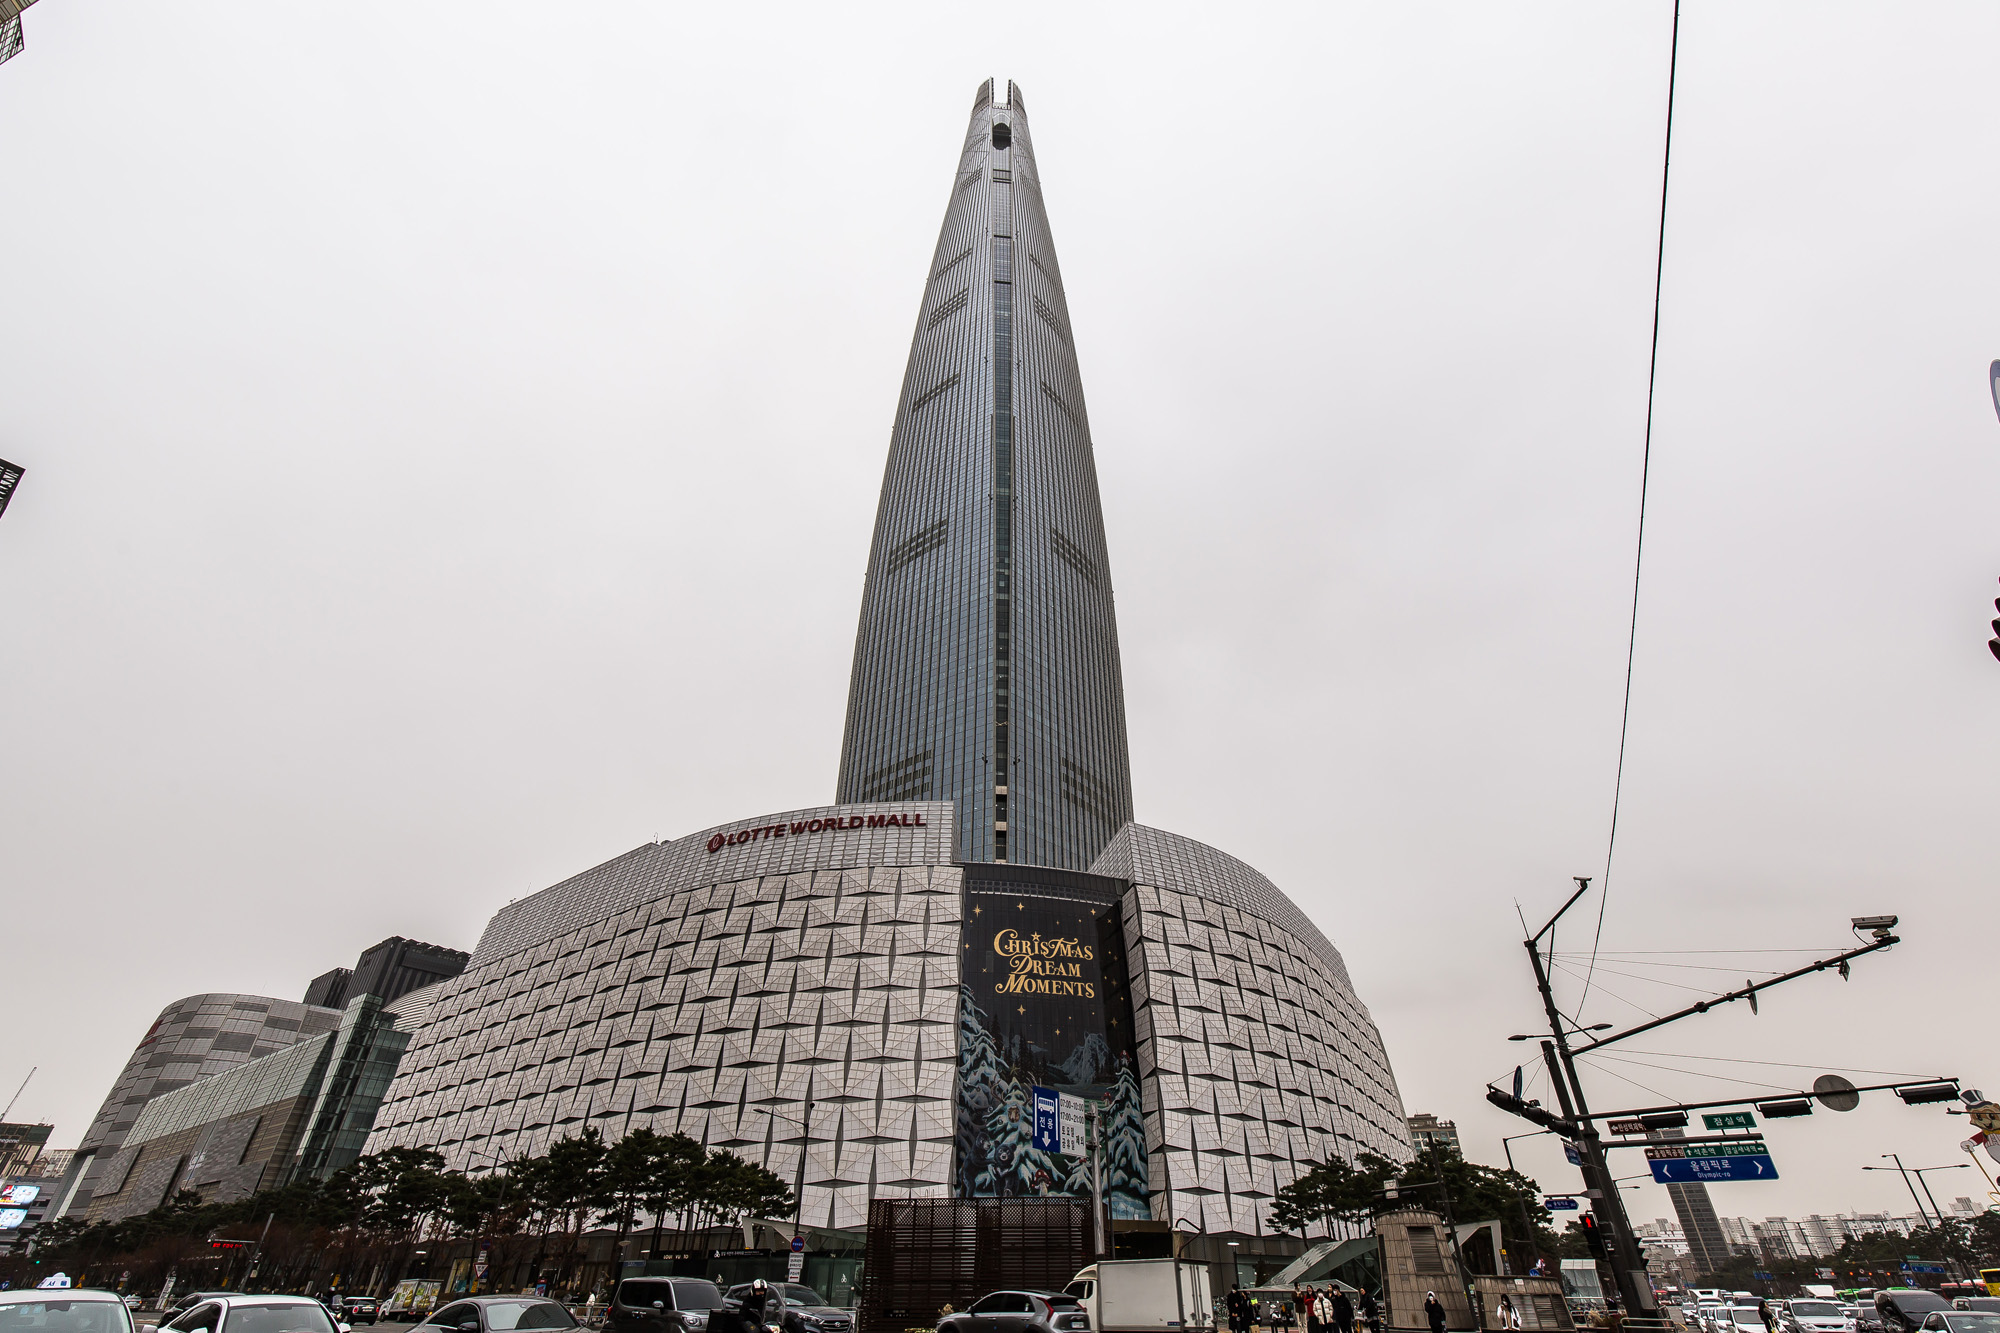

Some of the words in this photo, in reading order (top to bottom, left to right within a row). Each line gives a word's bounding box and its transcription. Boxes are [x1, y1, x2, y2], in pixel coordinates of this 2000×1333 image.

[727, 823, 787, 846] LOTTE
[790, 815, 864, 835] WORLD
[867, 813, 927, 829] MALL
[993, 928, 1094, 961] CHRISTMAS
[1009, 953, 1082, 978] DREAM
[995, 973, 1095, 999] MOMENTS
[1039, 1117, 1053, 1130] 전용
[1713, 1115, 1746, 1126] 잠실역
[1618, 1122, 1647, 1132] 한성백제박
[1654, 1148, 1685, 1158] 올림픽공원
[1693, 1147, 1717, 1156] 석촌역
[1725, 1145, 1758, 1155] 잠실새내역
[1690, 1159, 1732, 1172] 올림픽로
[1697, 1171, 1731, 1179] Olympic-ro
